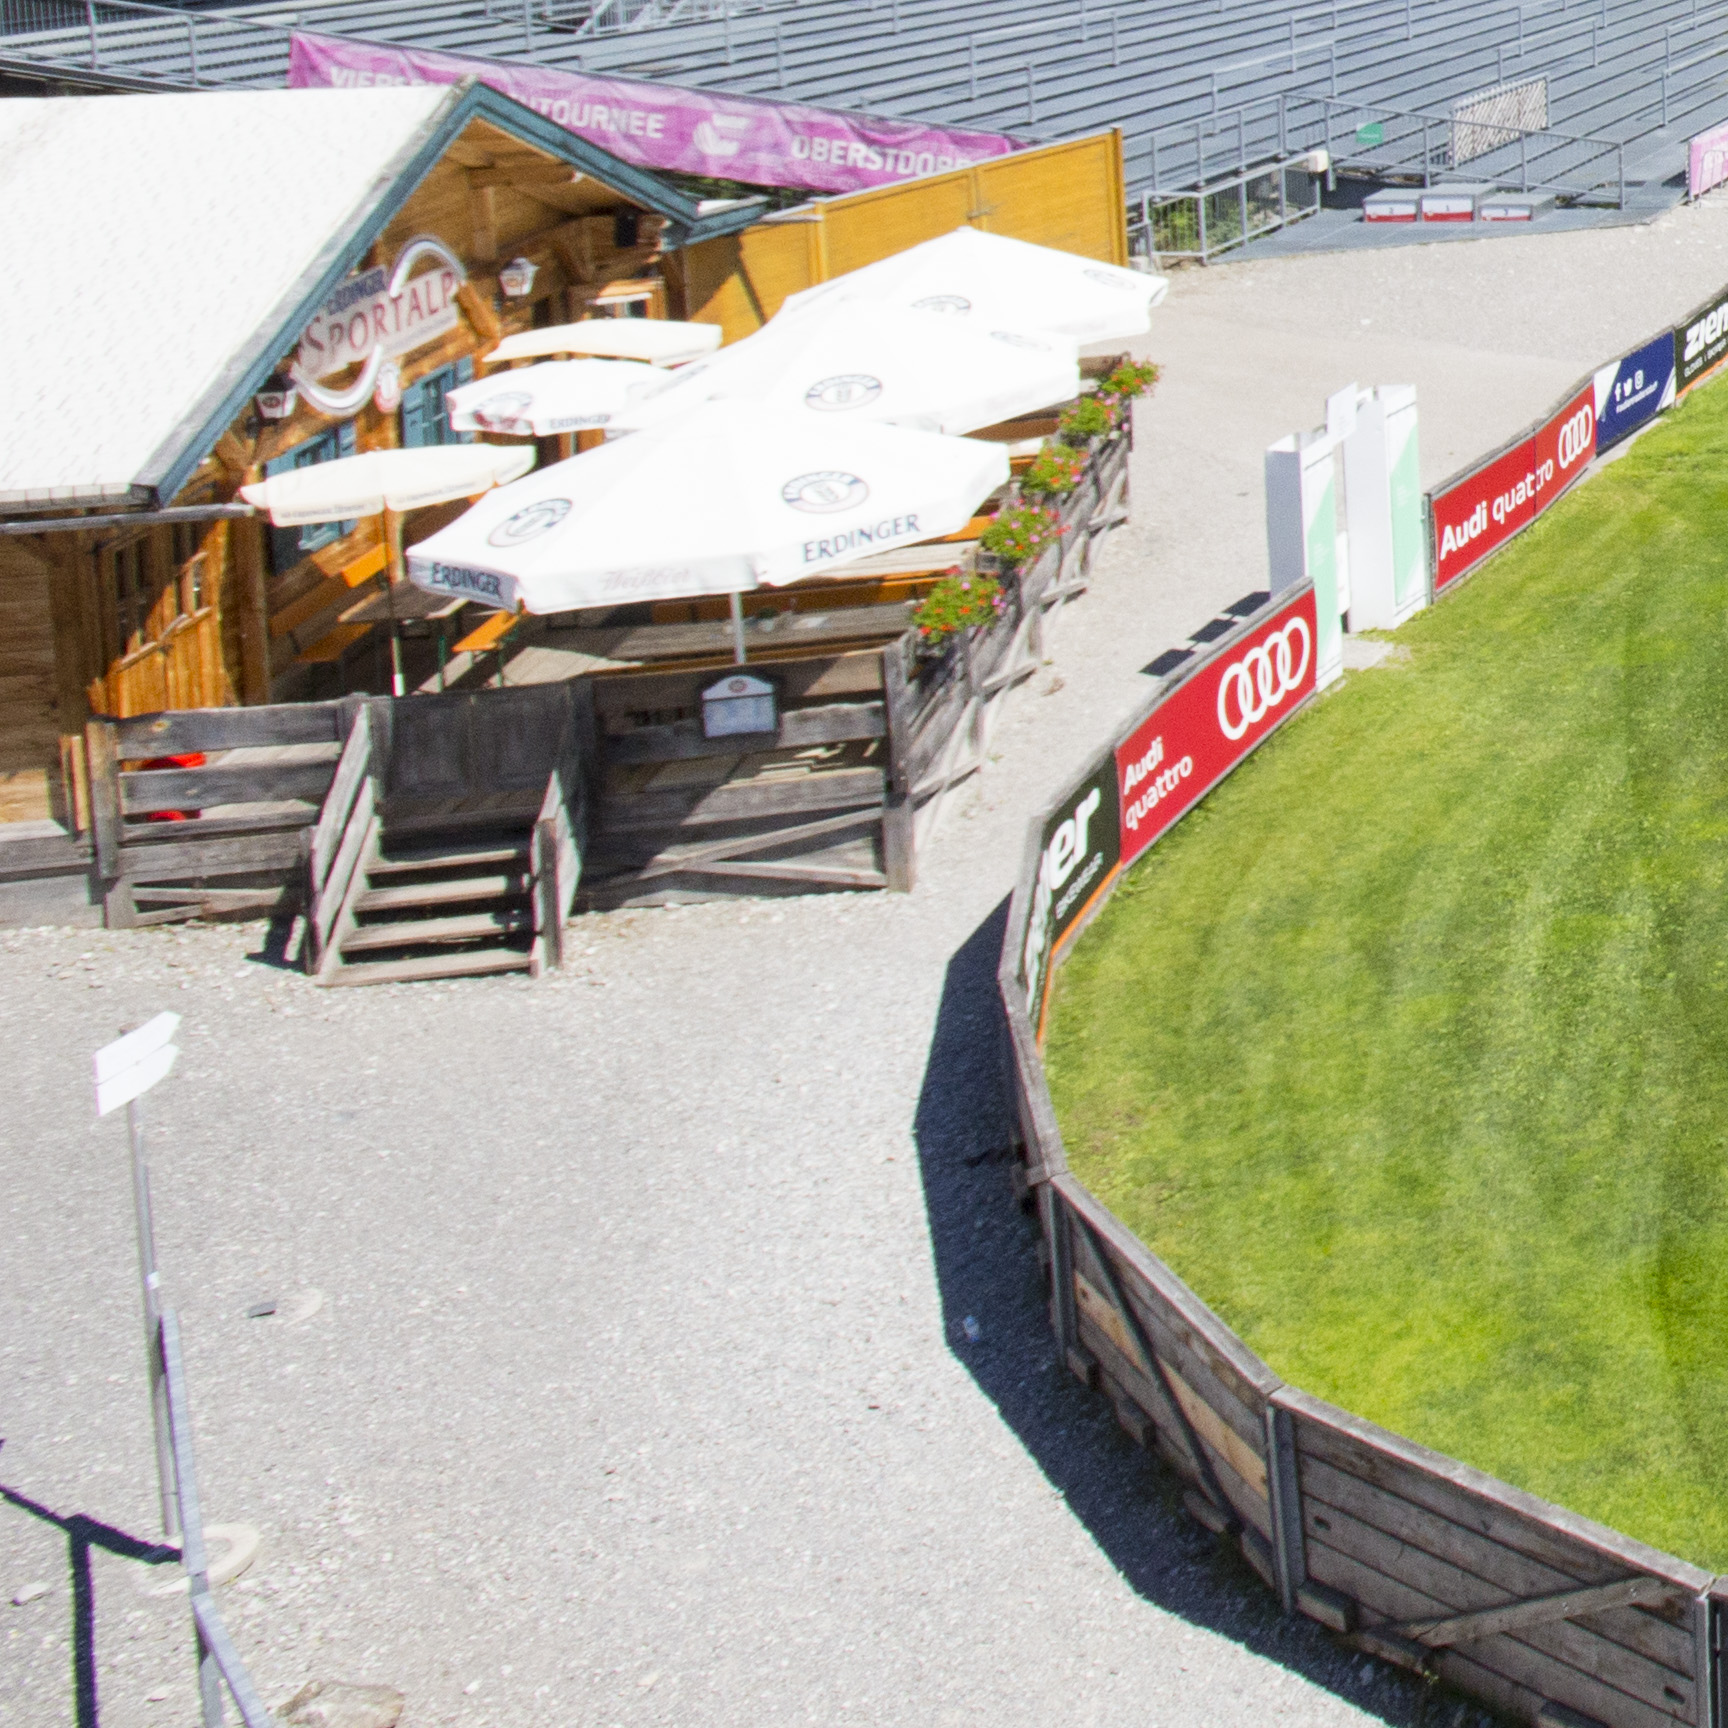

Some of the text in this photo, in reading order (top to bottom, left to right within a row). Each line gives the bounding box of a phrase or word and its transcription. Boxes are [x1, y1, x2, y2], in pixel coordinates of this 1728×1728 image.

[802, 513, 921, 565] ERDINGER
[1439, 500, 1488, 561] Audi
[430, 561, 502, 596] ERDINGER
[1123, 735, 1164, 796] Audi
[1125, 755, 1194, 832] quattro
